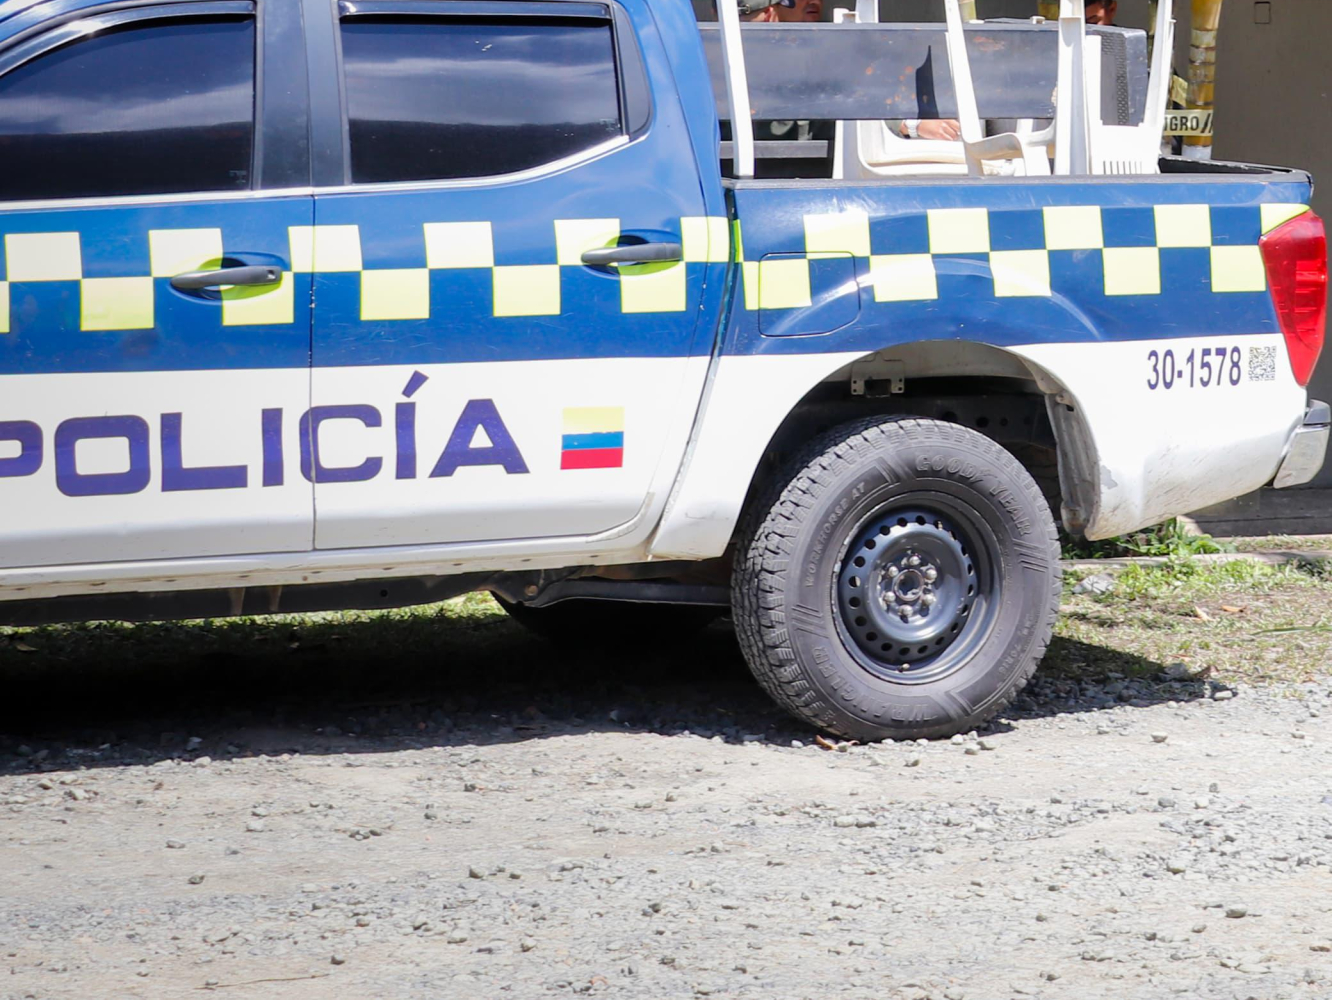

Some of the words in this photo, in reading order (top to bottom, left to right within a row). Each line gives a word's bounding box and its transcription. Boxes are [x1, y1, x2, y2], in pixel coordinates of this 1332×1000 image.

[1147, 345, 1242, 390] 30-1578
[806, 498, 849, 588] WORKHORSE
[852, 482, 866, 500] AT
[812, 646, 938, 722] WRANGLER
